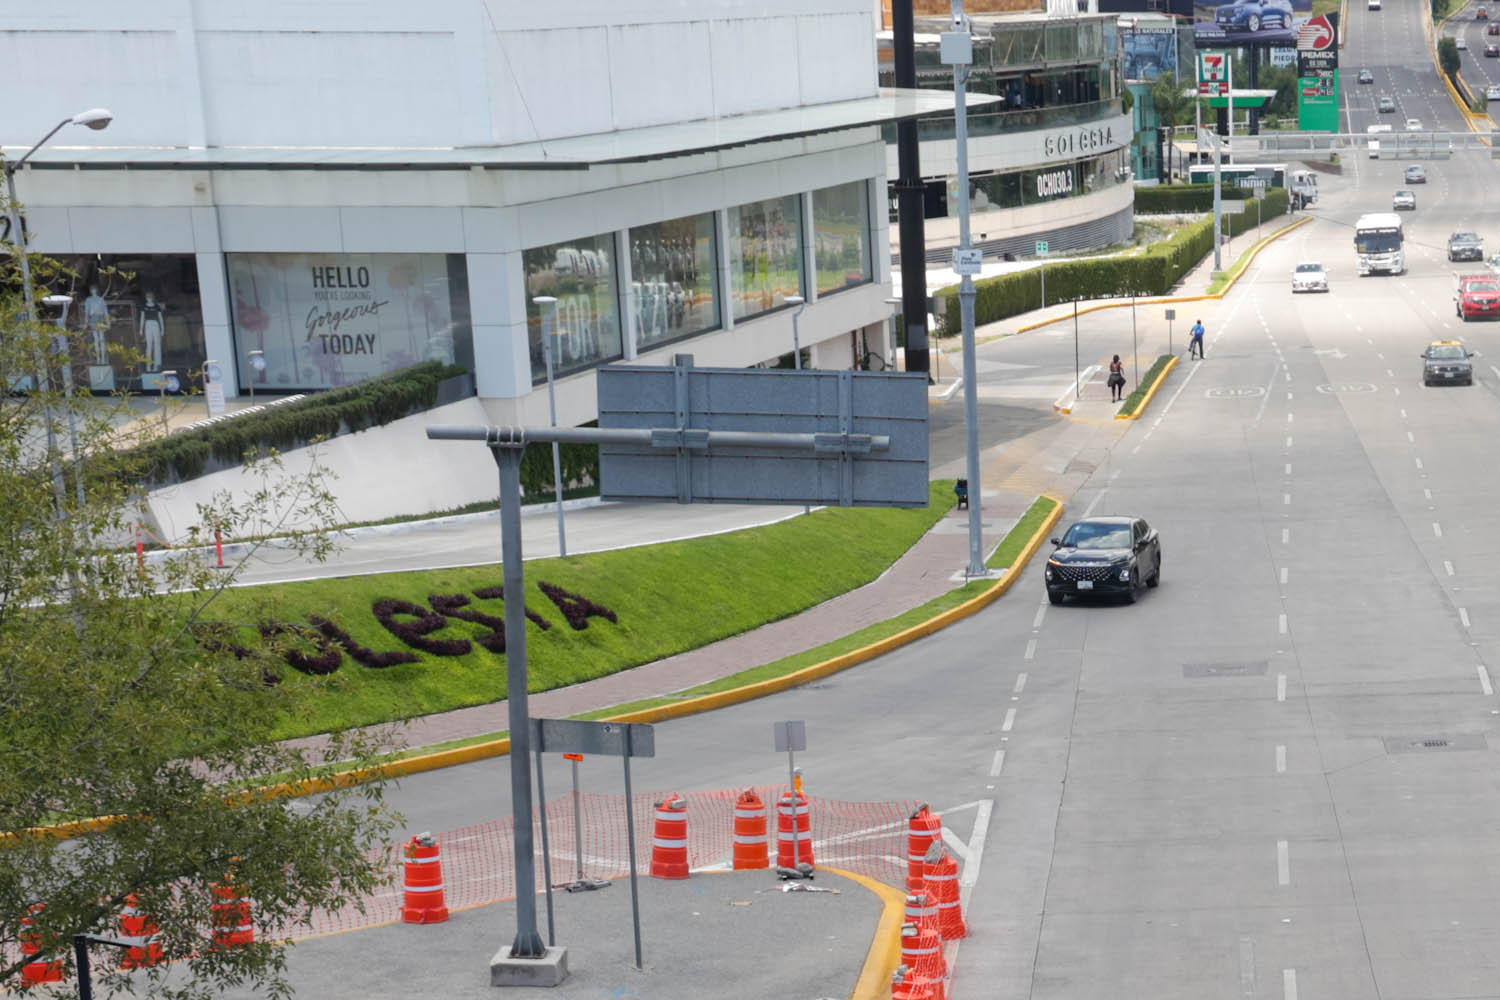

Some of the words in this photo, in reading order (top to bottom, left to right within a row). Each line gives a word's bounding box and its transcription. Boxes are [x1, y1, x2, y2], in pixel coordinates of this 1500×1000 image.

[1301, 51, 1336, 59] PEMEX
[1239, 179, 1266, 189] INDIO
[312, 266, 370, 289] HELLO
[341, 290, 372, 300] LOOKING
[306, 300, 389, 342] Gorgeous
[319, 333, 375, 355] TODAY
